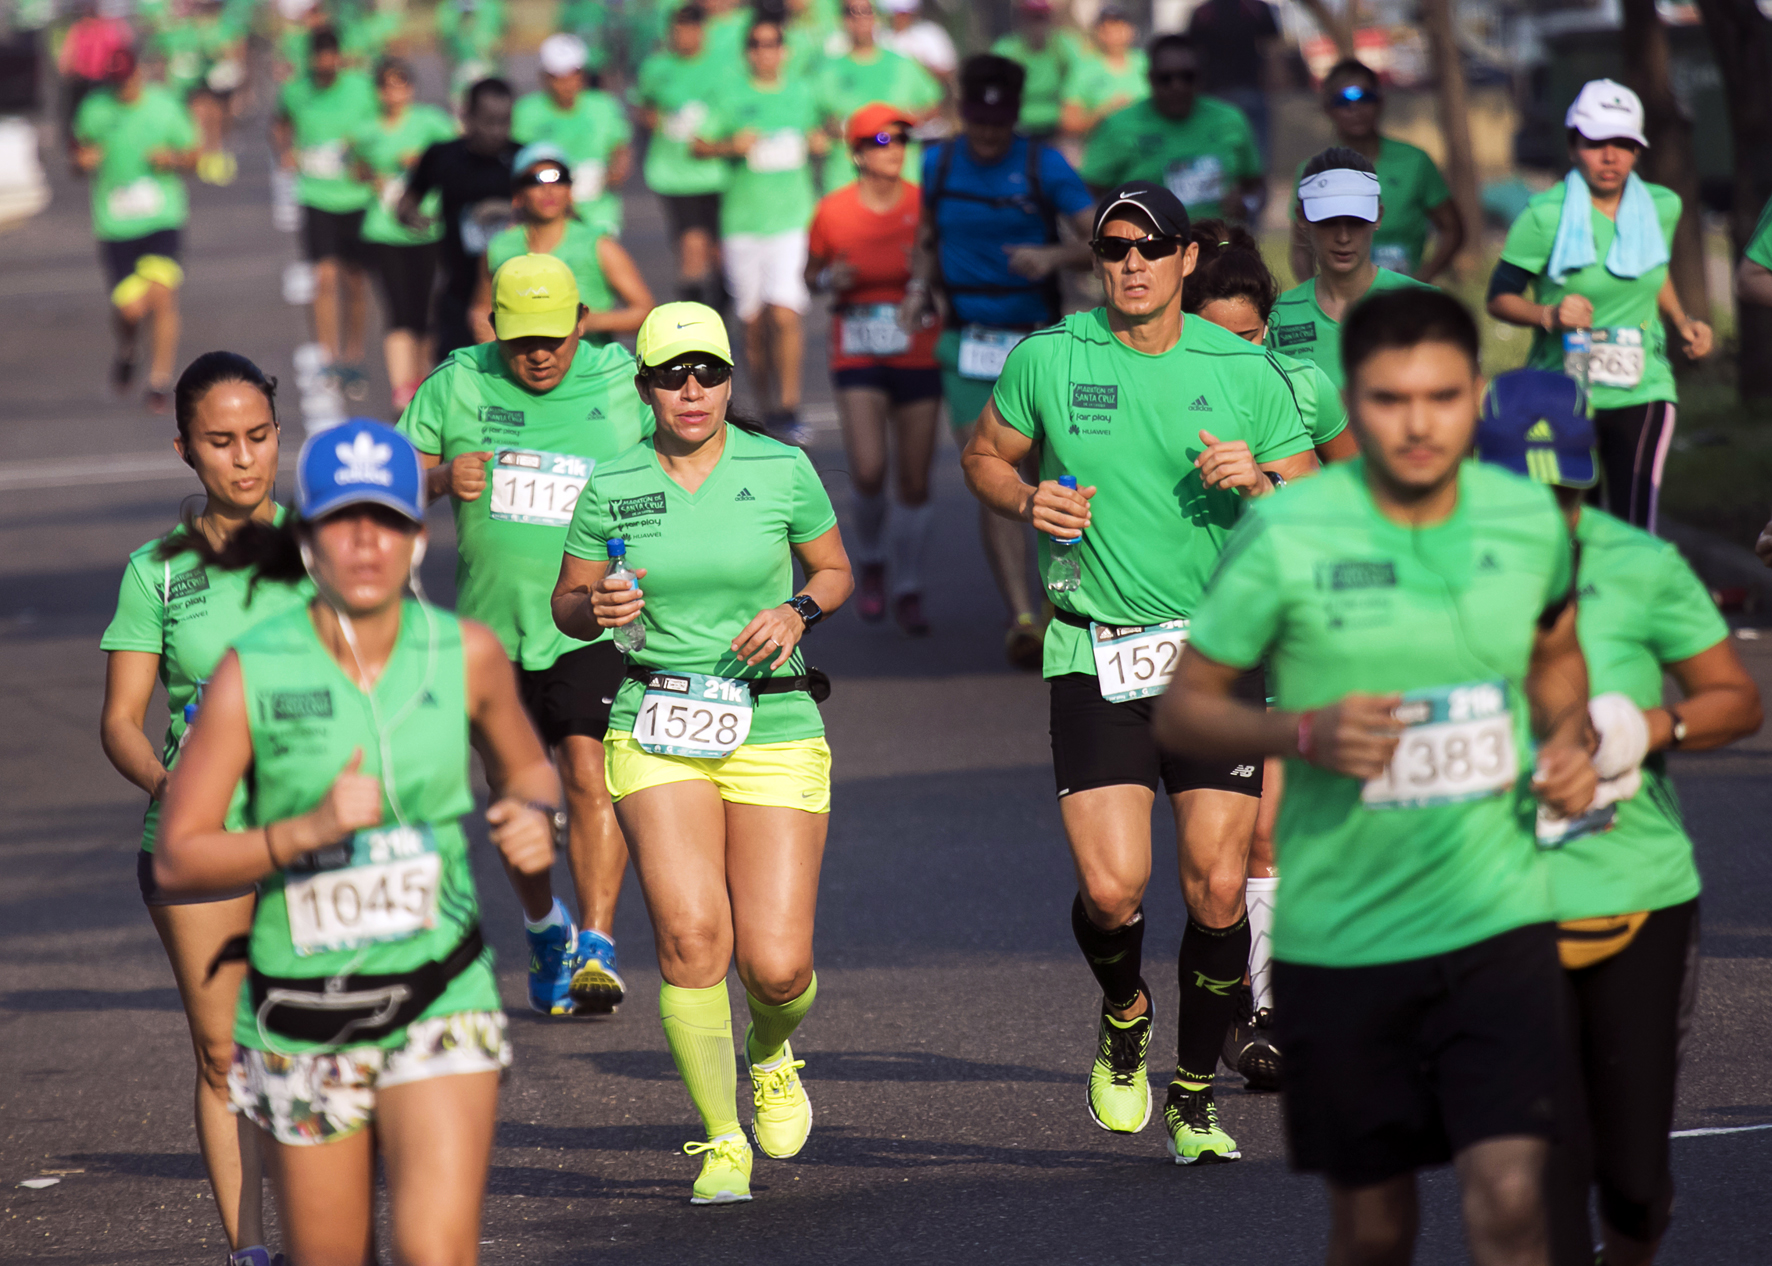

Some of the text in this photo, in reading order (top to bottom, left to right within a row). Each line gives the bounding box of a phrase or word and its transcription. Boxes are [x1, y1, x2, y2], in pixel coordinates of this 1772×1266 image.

[1074, 393, 1115, 404] SANTA CRUZ
[1076, 412, 1111, 424] fair play
[504, 477, 581, 513] 1112
[620, 503, 645, 513] SANTA
[645, 501, 664, 510] CRUZ
[640, 518, 661, 528] play
[632, 531, 662, 540] HUAWEI
[646, 702, 739, 745] 1528
[301, 867, 431, 932] 1045
